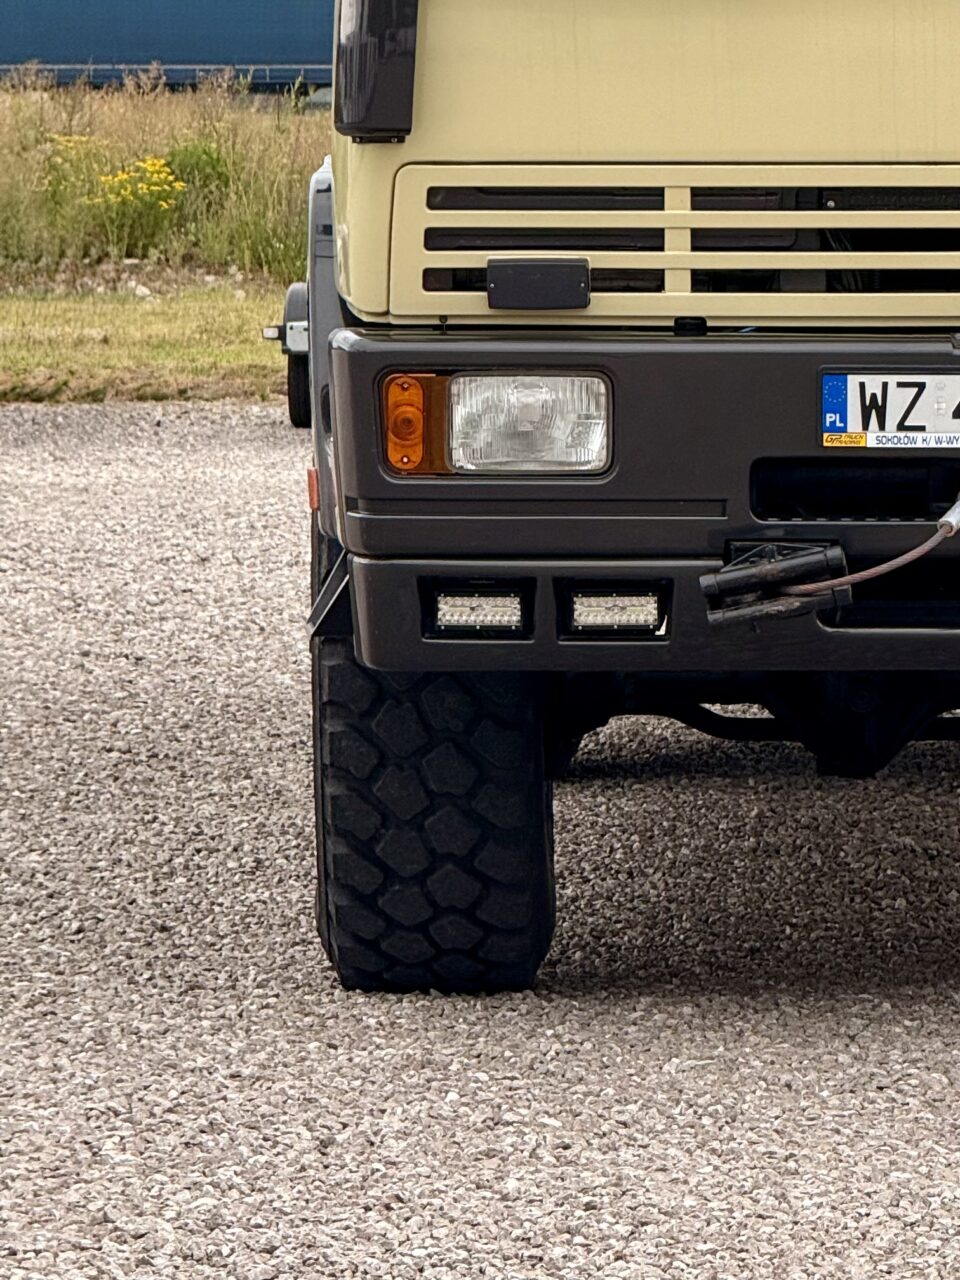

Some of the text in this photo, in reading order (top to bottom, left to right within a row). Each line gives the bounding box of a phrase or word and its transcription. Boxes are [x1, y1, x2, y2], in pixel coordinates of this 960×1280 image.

[858, 381, 926, 431] WZ
[826, 414, 844, 428] PL
[875, 434, 918, 446] SOKOŁÓW
[935, 435, 960, 446] W-WY
